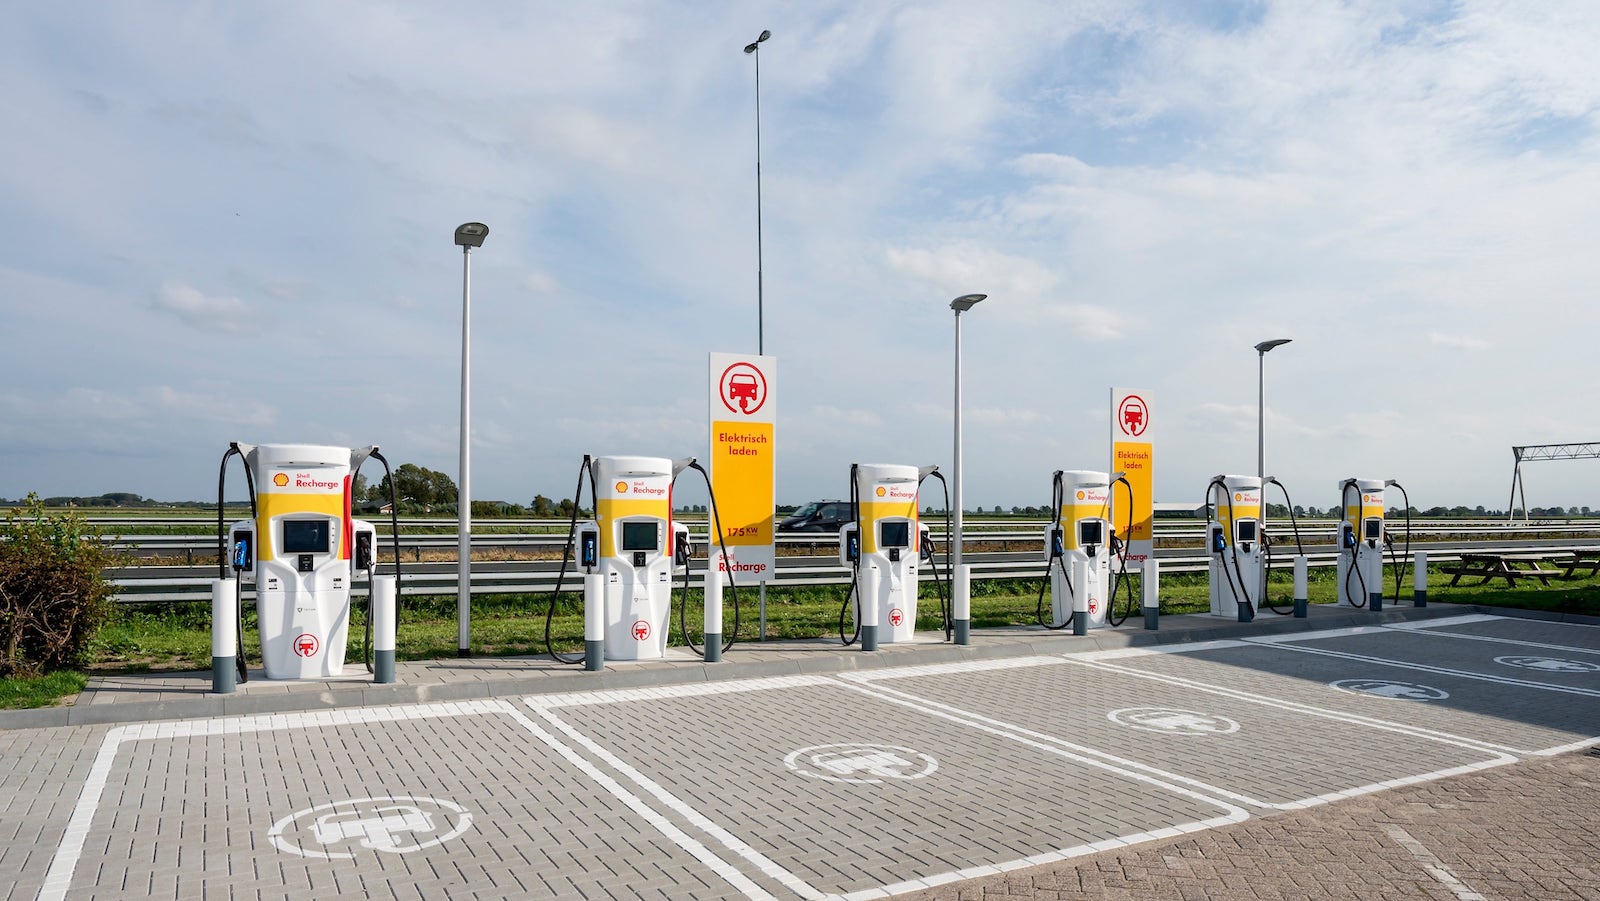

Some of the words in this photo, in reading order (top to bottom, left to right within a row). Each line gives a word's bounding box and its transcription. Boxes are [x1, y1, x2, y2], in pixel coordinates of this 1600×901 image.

[719, 432, 767, 443] Elektrisch
[729, 445, 758, 456] laden
[1117, 451, 1149, 459] Elektrisch
[1123, 461, 1143, 469] laden
[296, 480, 339, 489] Recharge
[633, 486, 666, 495] Recharge
[727, 527, 745, 537] 175
